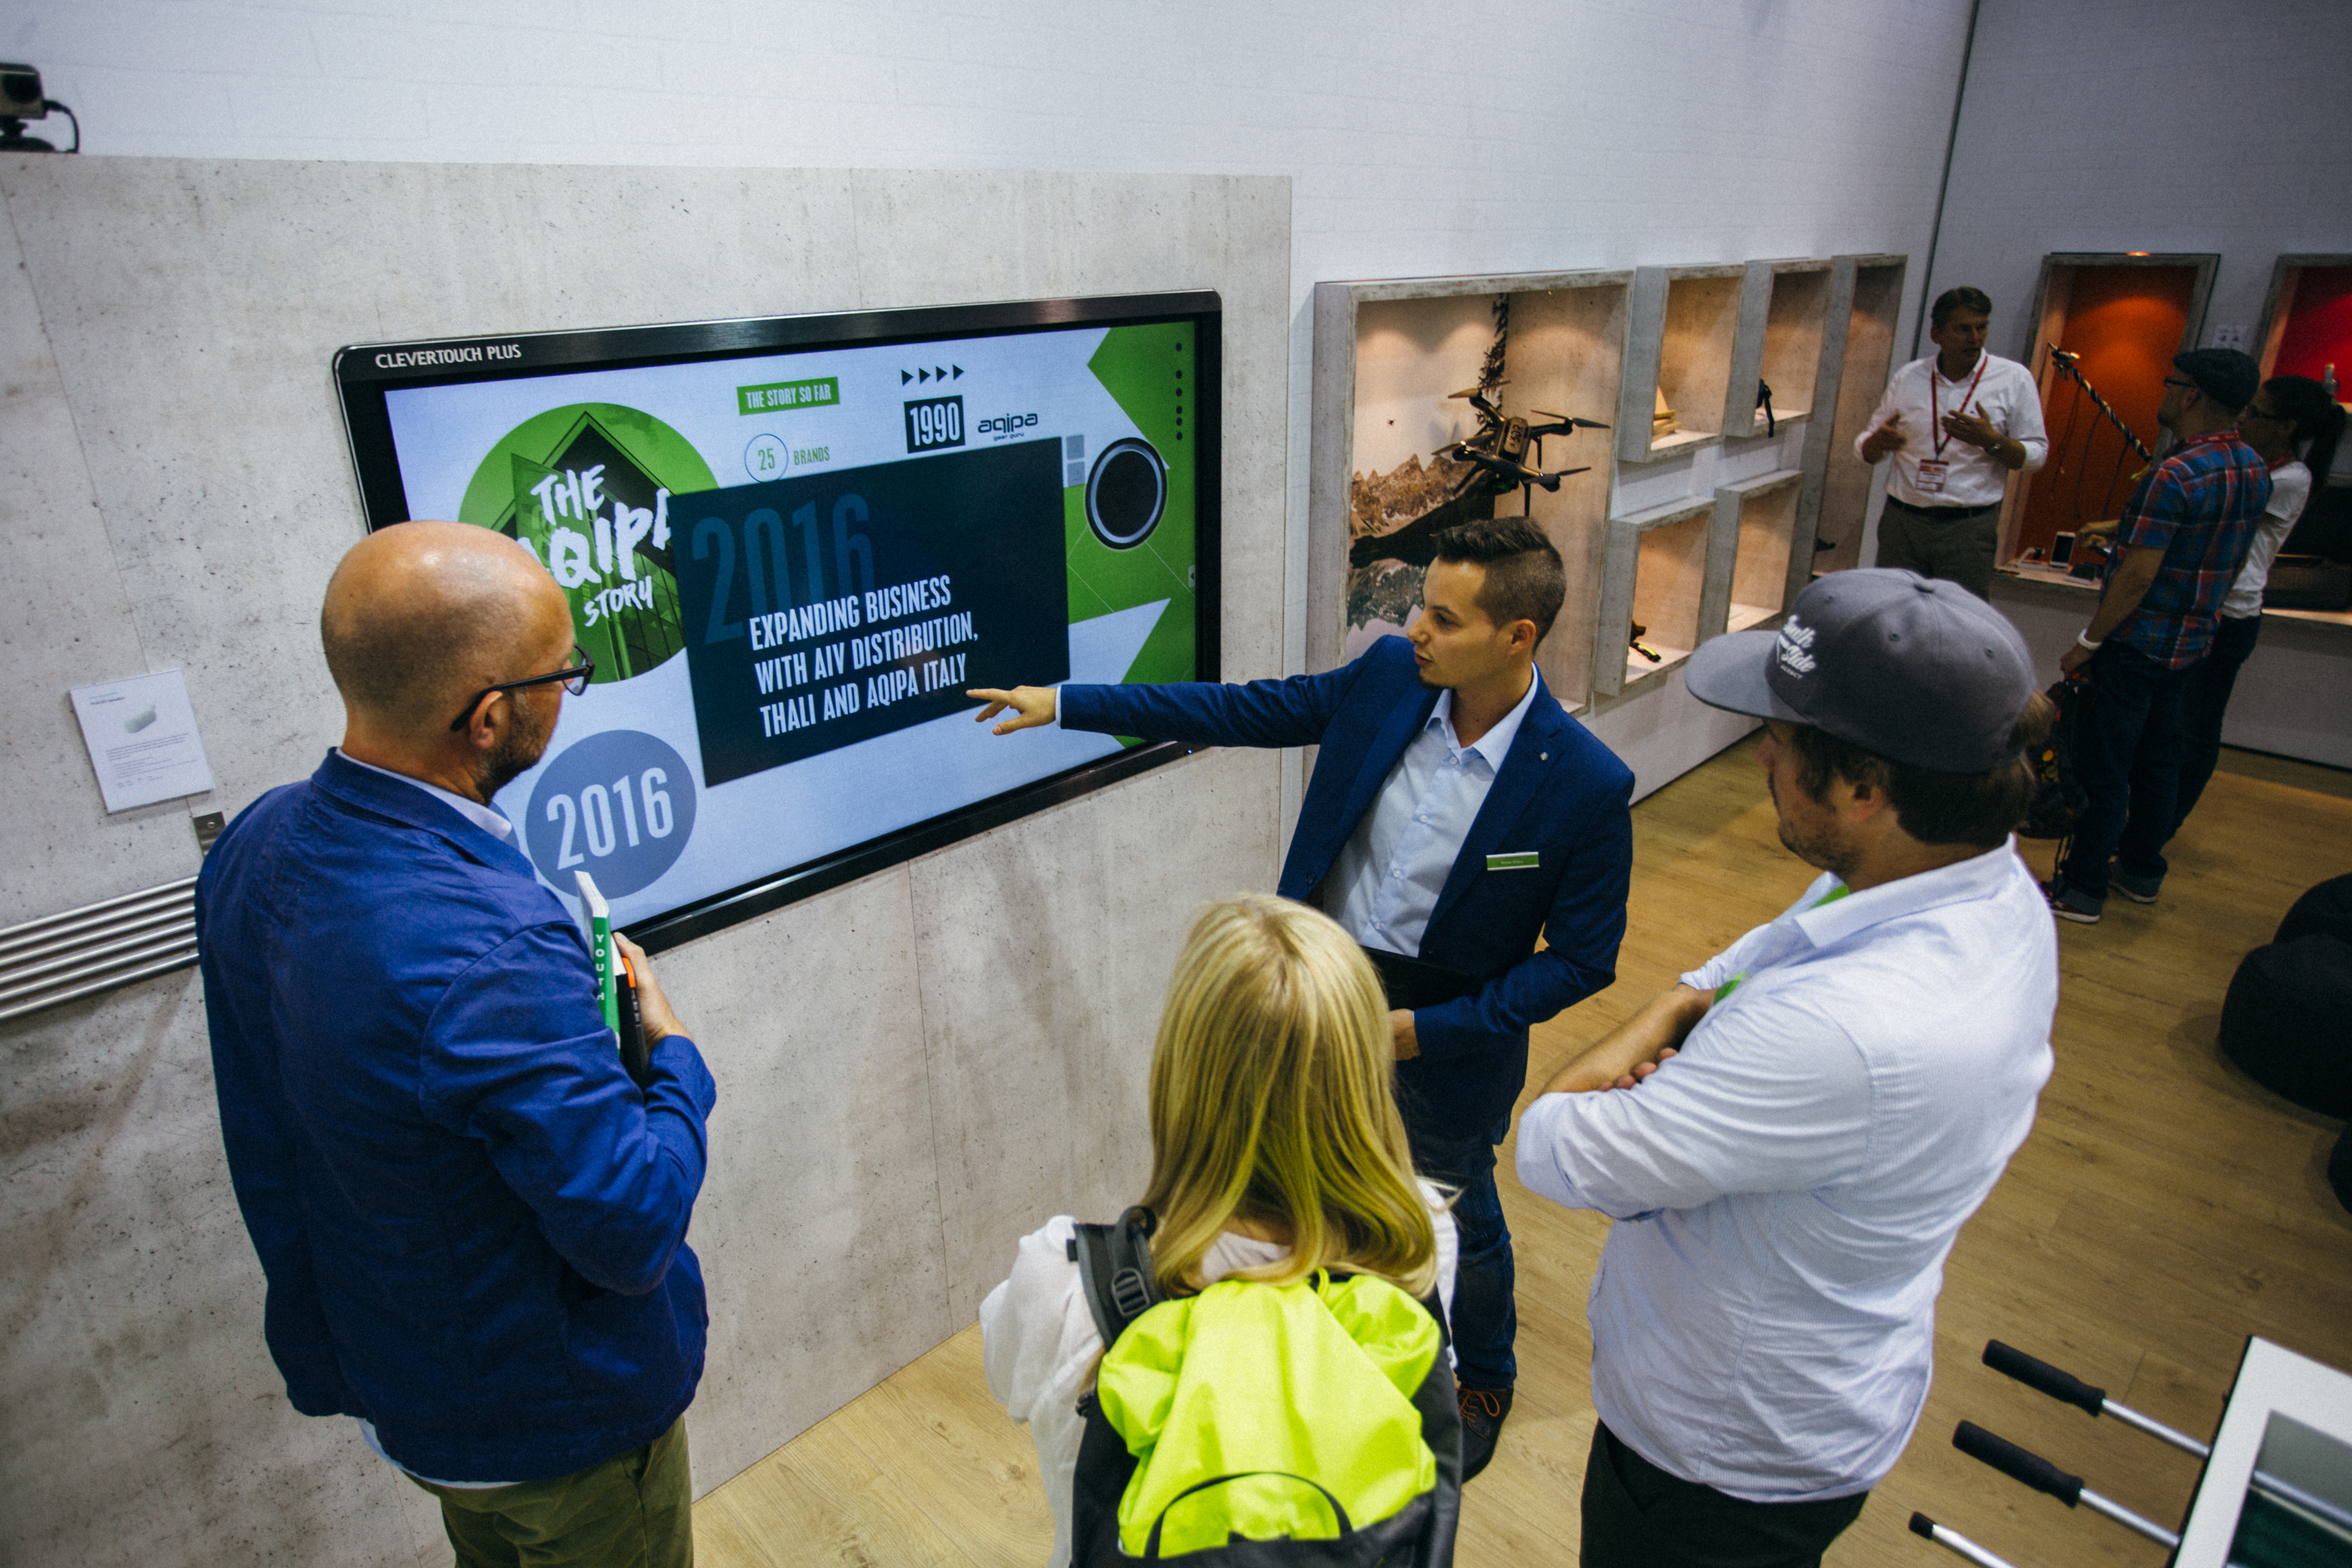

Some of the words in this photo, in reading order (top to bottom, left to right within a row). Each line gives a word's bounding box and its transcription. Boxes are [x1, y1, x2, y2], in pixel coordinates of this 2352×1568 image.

[375, 347, 482, 368] CLEVERTOUCH
[486, 344, 521, 360] PLUS
[745, 391, 765, 409] THE
[766, 388, 796, 406] STORY
[799, 386, 812, 403] SO
[814, 384, 831, 401] FAR
[910, 402, 961, 446] 1990
[978, 413, 1038, 433] aqipa
[758, 448, 775, 470] 25
[794, 446, 830, 465] BRANDS
[530, 464, 605, 525] THE
[517, 487, 671, 589] QIP
[692, 493, 875, 645] 2016
[584, 576, 653, 627] STORY
[749, 595, 860, 651] EXPANDING
[865, 575, 951, 623] BUSINESS
[754, 652, 808, 695] WITH
[851, 611, 978, 670] DISTRIBUTION,
[760, 694, 816, 737] THALI
[824, 683, 860, 721] AND
[867, 666, 919, 708] AQIPA
[924, 653, 966, 692] ITALY
[546, 767, 674, 870] 2016
[595, 934, 605, 1001] YOUTH
